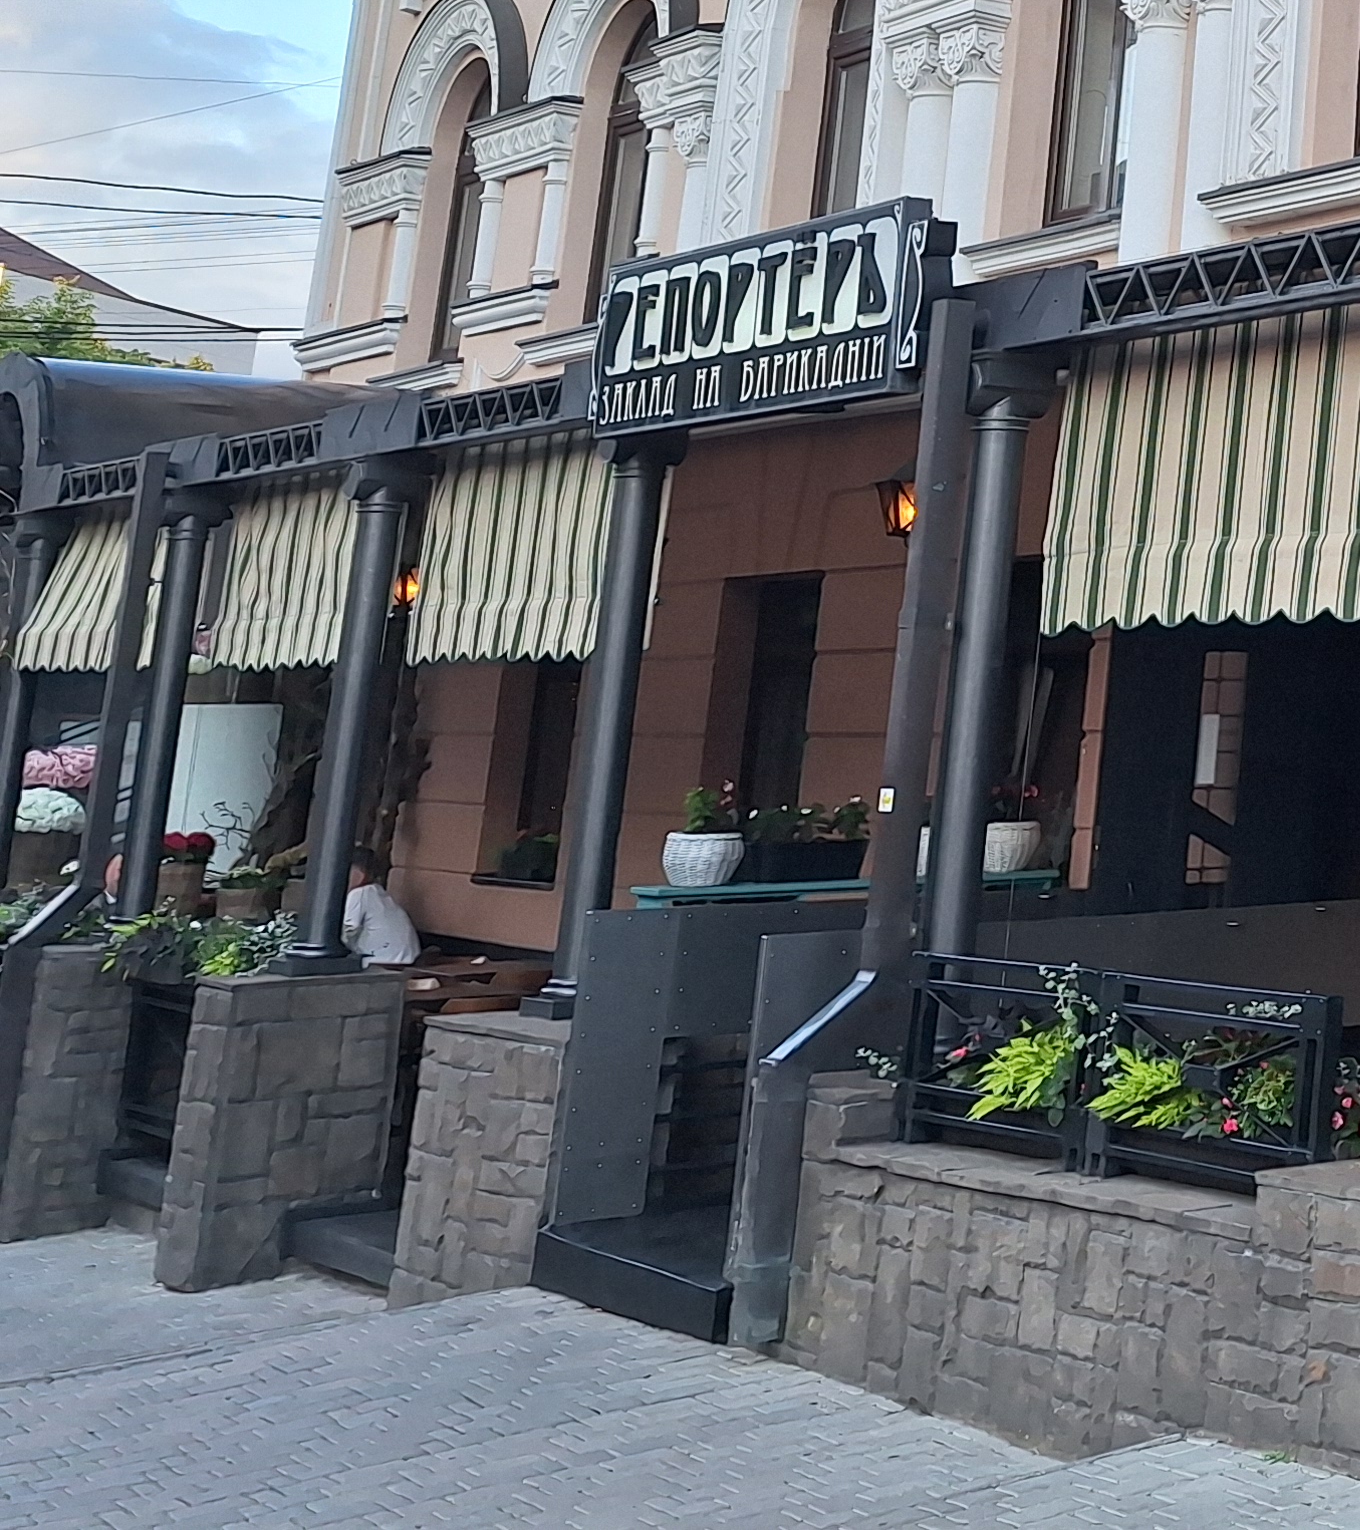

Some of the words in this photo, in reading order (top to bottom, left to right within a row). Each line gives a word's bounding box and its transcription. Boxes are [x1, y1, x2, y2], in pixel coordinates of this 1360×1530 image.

[604, 230, 888, 367] РЕПОРТЁРЪ
[599, 374, 678, 426] ЗАКЛАД
[693, 365, 722, 410] НА
